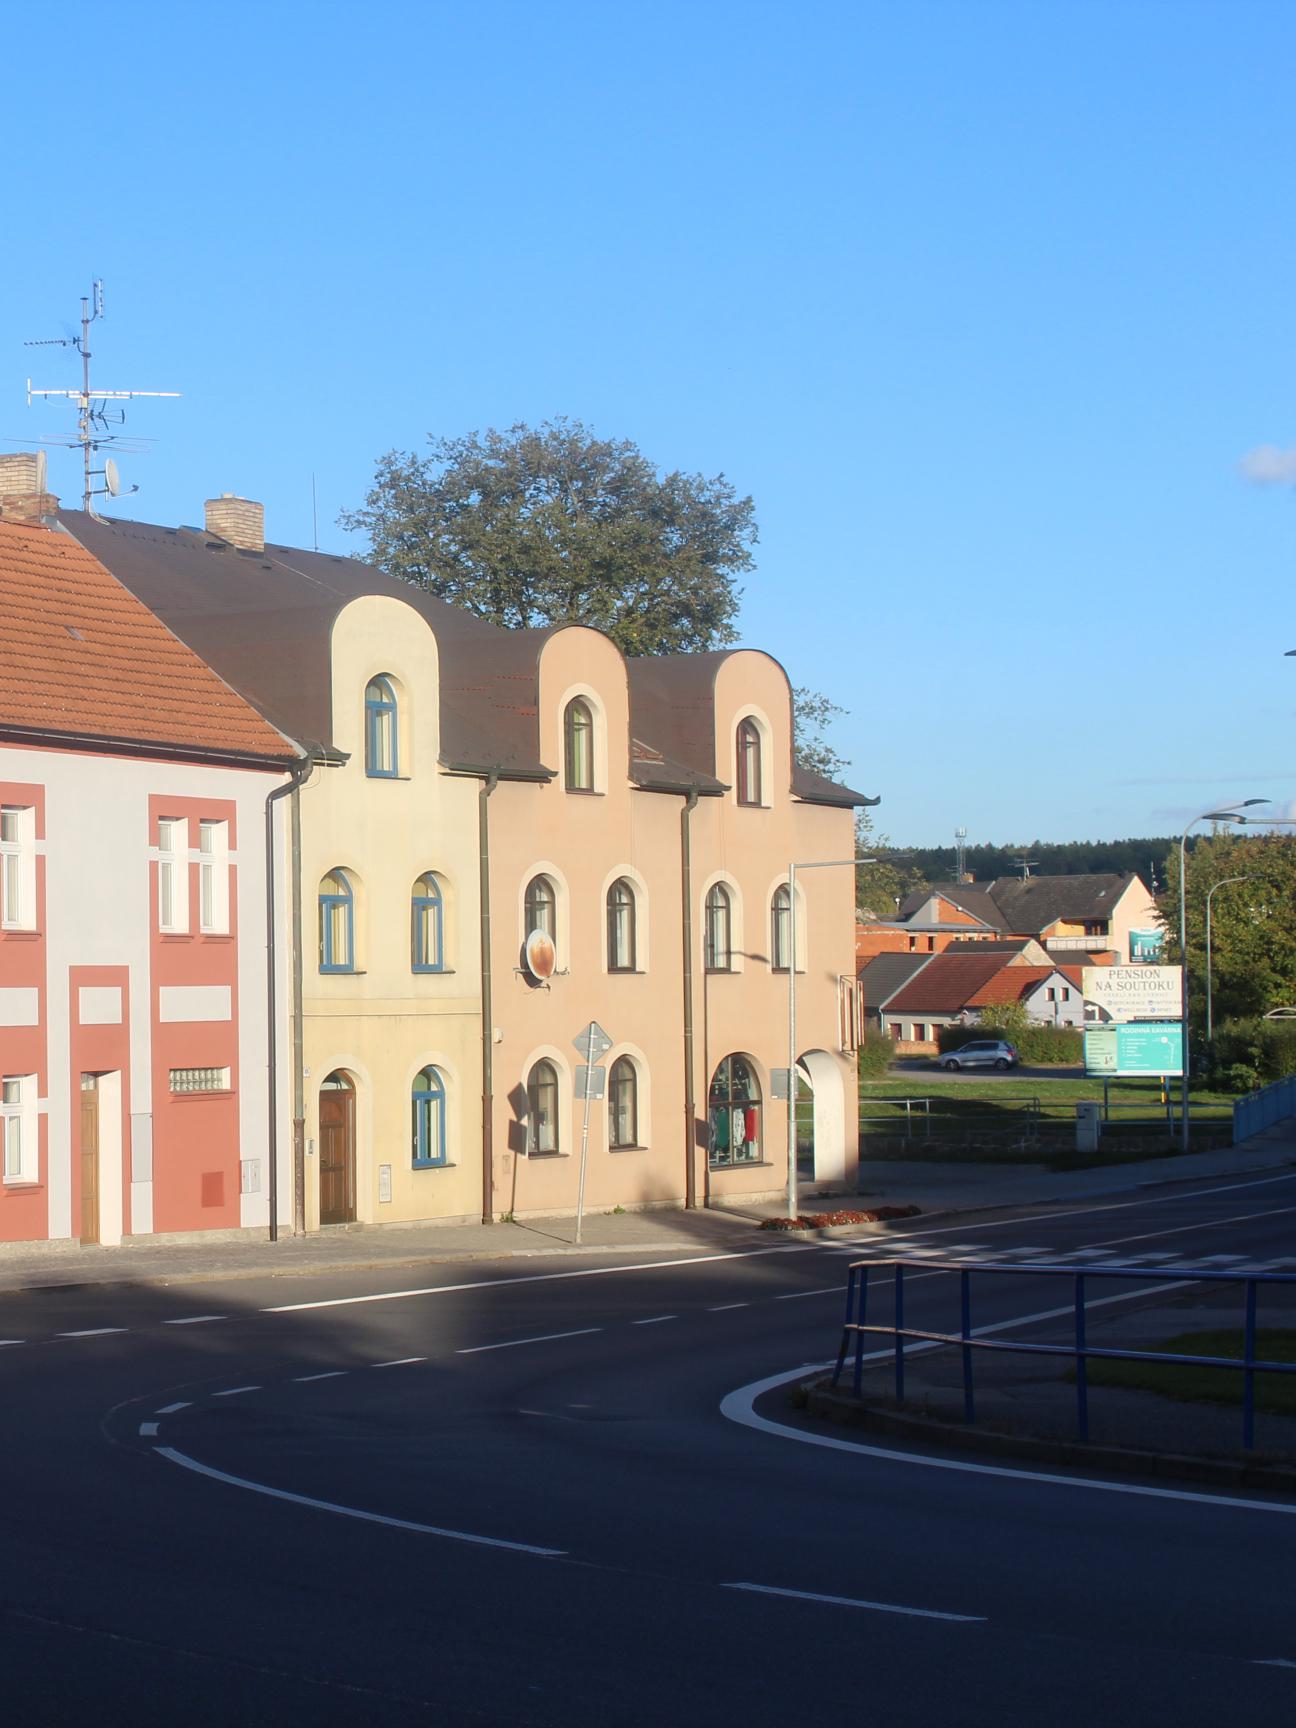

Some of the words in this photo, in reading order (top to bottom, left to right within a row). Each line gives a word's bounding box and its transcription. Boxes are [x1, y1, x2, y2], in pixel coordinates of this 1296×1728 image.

[1108, 969, 1161, 980] PENSION
[1095, 981, 1113, 991] NA
[1116, 980, 1175, 991] SOUTOKU
